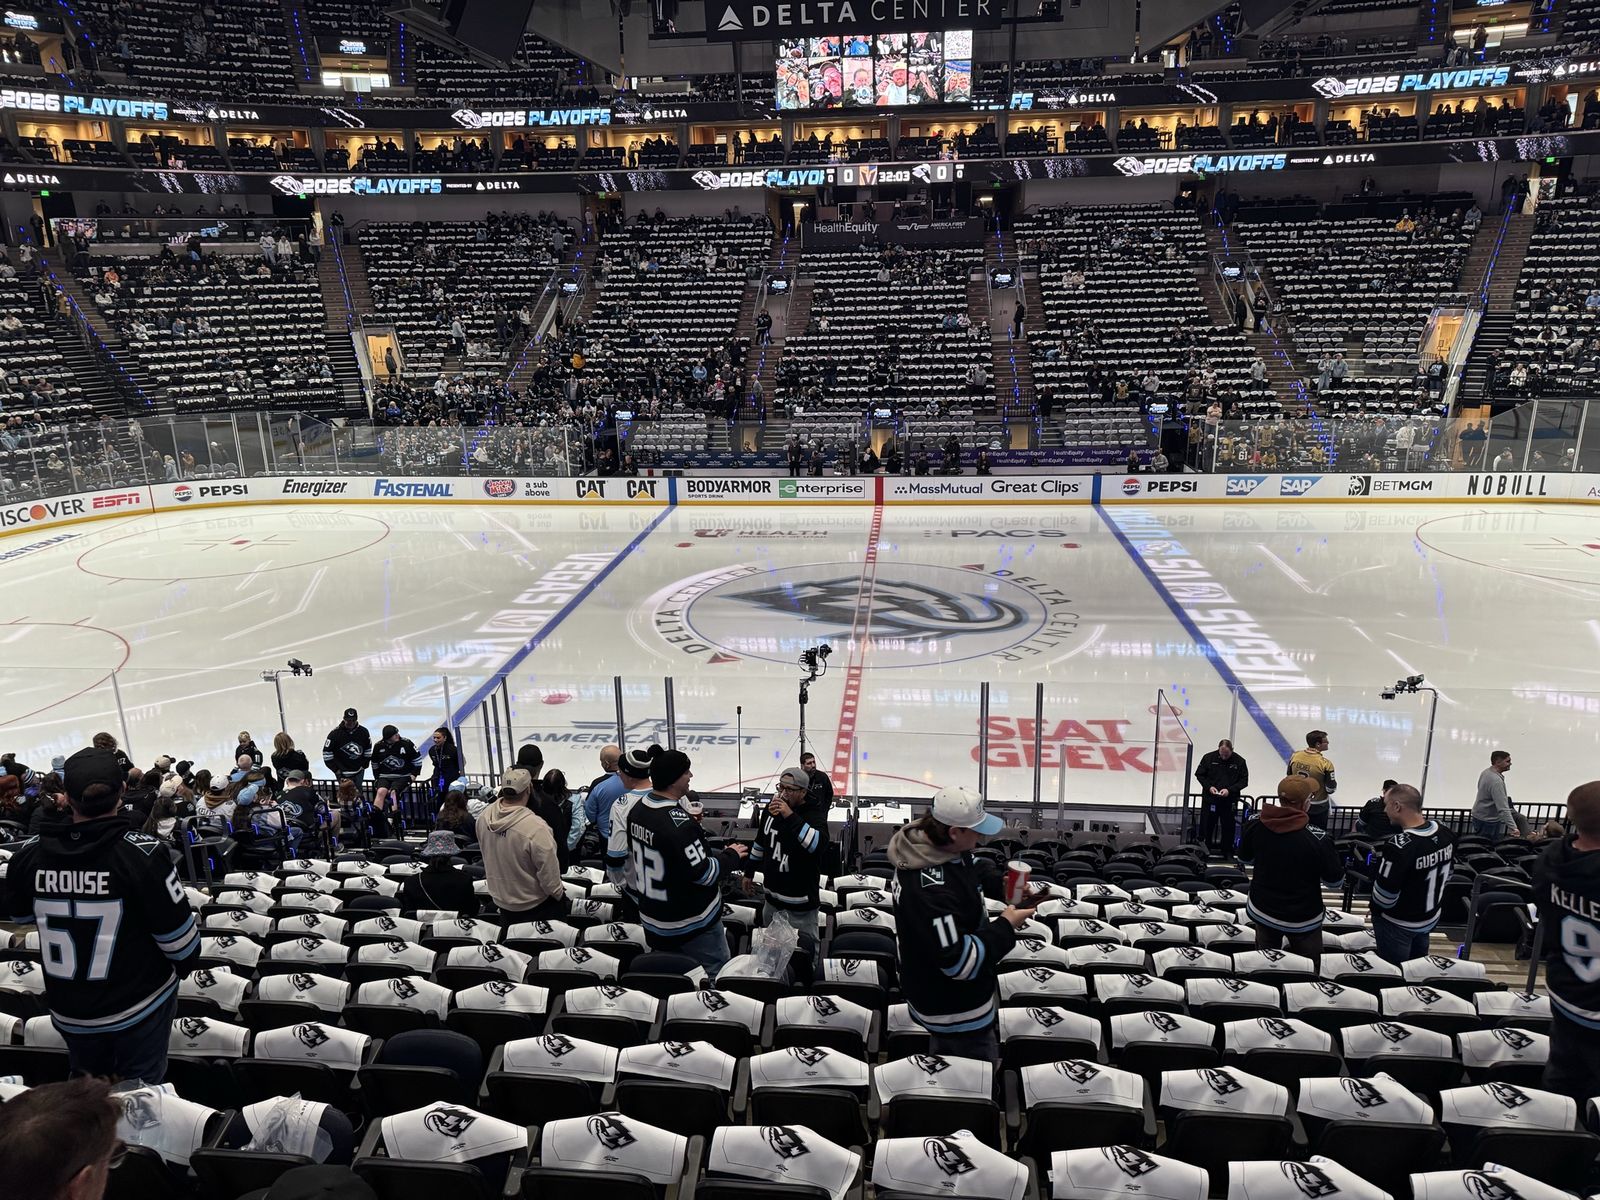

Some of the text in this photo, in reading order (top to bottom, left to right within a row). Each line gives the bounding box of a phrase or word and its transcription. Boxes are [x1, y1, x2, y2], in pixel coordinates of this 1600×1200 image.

[753, 0, 991, 27] DELTA CENTER
[1344, 76, 1400, 95] 2026
[1401, 67, 1510, 92] PLAYOFFS
[1568, 61, 1600, 74] DELT
[1, 90, 60, 112] 2026
[64, 95, 168, 121] PLAYOFFS
[219, 109, 260, 120] DELTA
[1080, 93, 1116, 103] DELTA
[481, 111, 526, 127] 2026
[528, 108, 611, 126] PLAYOFFS
[653, 109, 688, 119] DELTA
[1144, 158, 1192, 174] 2026
[1193, 154, 1287, 173] PLAYOFFS
[1335, 153, 1375, 164] DELTA
[16, 173, 61, 185] DELTA
[720, 172, 764, 188] 2026
[827, 174, 834, 183] 0
[844, 169, 854, 183] 0
[878, 170, 911, 183] 32:03
[936, 165, 947, 180] 0
[956, 170, 963, 179] 0
[302, 178, 350, 194] 2026
[354, 178, 442, 194] PLAYOFFS
[486, 181, 520, 190] DELTA
[813, 221, 878, 235] HealthEquity
[1016, 450, 1046, 458] HealthEquity
[1238, 452, 1248, 461] 61
[174, 489, 193, 497] PEPSI
[200, 484, 249, 498] PEPSI
[282, 479, 348, 496] Energizer
[374, 479, 454, 498] FASTENAL
[576, 480, 607, 499] CAT
[626, 480, 656, 499] CAT
[686, 480, 772, 494] BODYARMOR
[783, 481, 864, 496] enterprise
[908, 483, 983, 495] MassMutual
[990, 480, 1080, 497] Great Clips
[1147, 480, 1198, 493] PEPSI
[1226, 479, 1258, 493] SAP
[1280, 479, 1313, 493] SAP
[1373, 480, 1433, 492] BETMGM
[1467, 475, 1547, 496] NOBULL
[93, 492, 140, 509] ESPN
[951, 529, 1067, 539] PACS
[512, 551, 618, 605] VEGAS
[666, 565, 767, 603] CENTER
[990, 569, 1081, 662] DELTA CENTER
[656, 608, 712, 655] DELTA
[1184, 608, 1319, 693] VEGAS
[976, 715, 1133, 744] SEAT
[519, 733, 761, 747] AMERICA FIRST
[970, 742, 1158, 774] GEEK
[630, 822, 654, 847] COOLEY
[763, 816, 790, 873] UTAH
[1415, 843, 1454, 870] GUETH
[631, 838, 668, 902] 92
[34, 869, 111, 896] CROUSE
[165, 864, 185, 905] 6
[1424, 861, 1452, 914] 11
[33, 898, 123, 981] 67
[932, 914, 959, 949] 11
